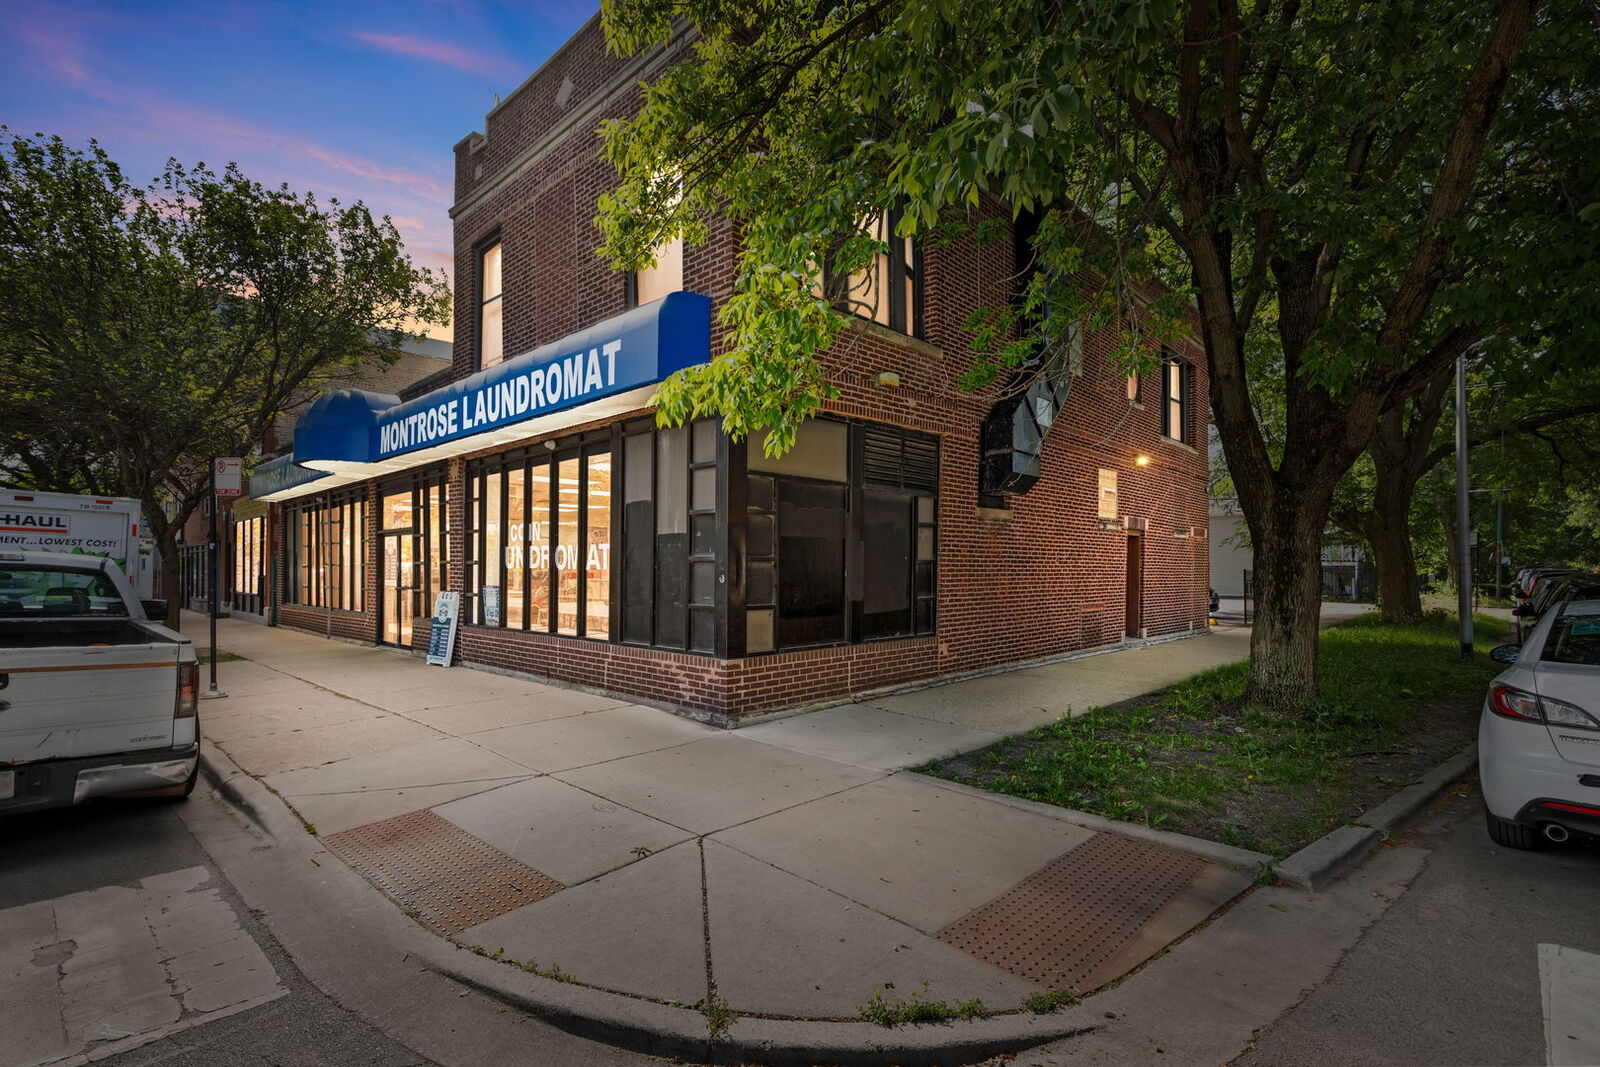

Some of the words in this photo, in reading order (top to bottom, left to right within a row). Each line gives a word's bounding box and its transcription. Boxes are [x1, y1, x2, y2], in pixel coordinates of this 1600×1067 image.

[380, 399, 457, 454] MONTROSE
[462, 339, 622, 430] LAUNDROMAT
[86, 539, 118, 548] COST!
